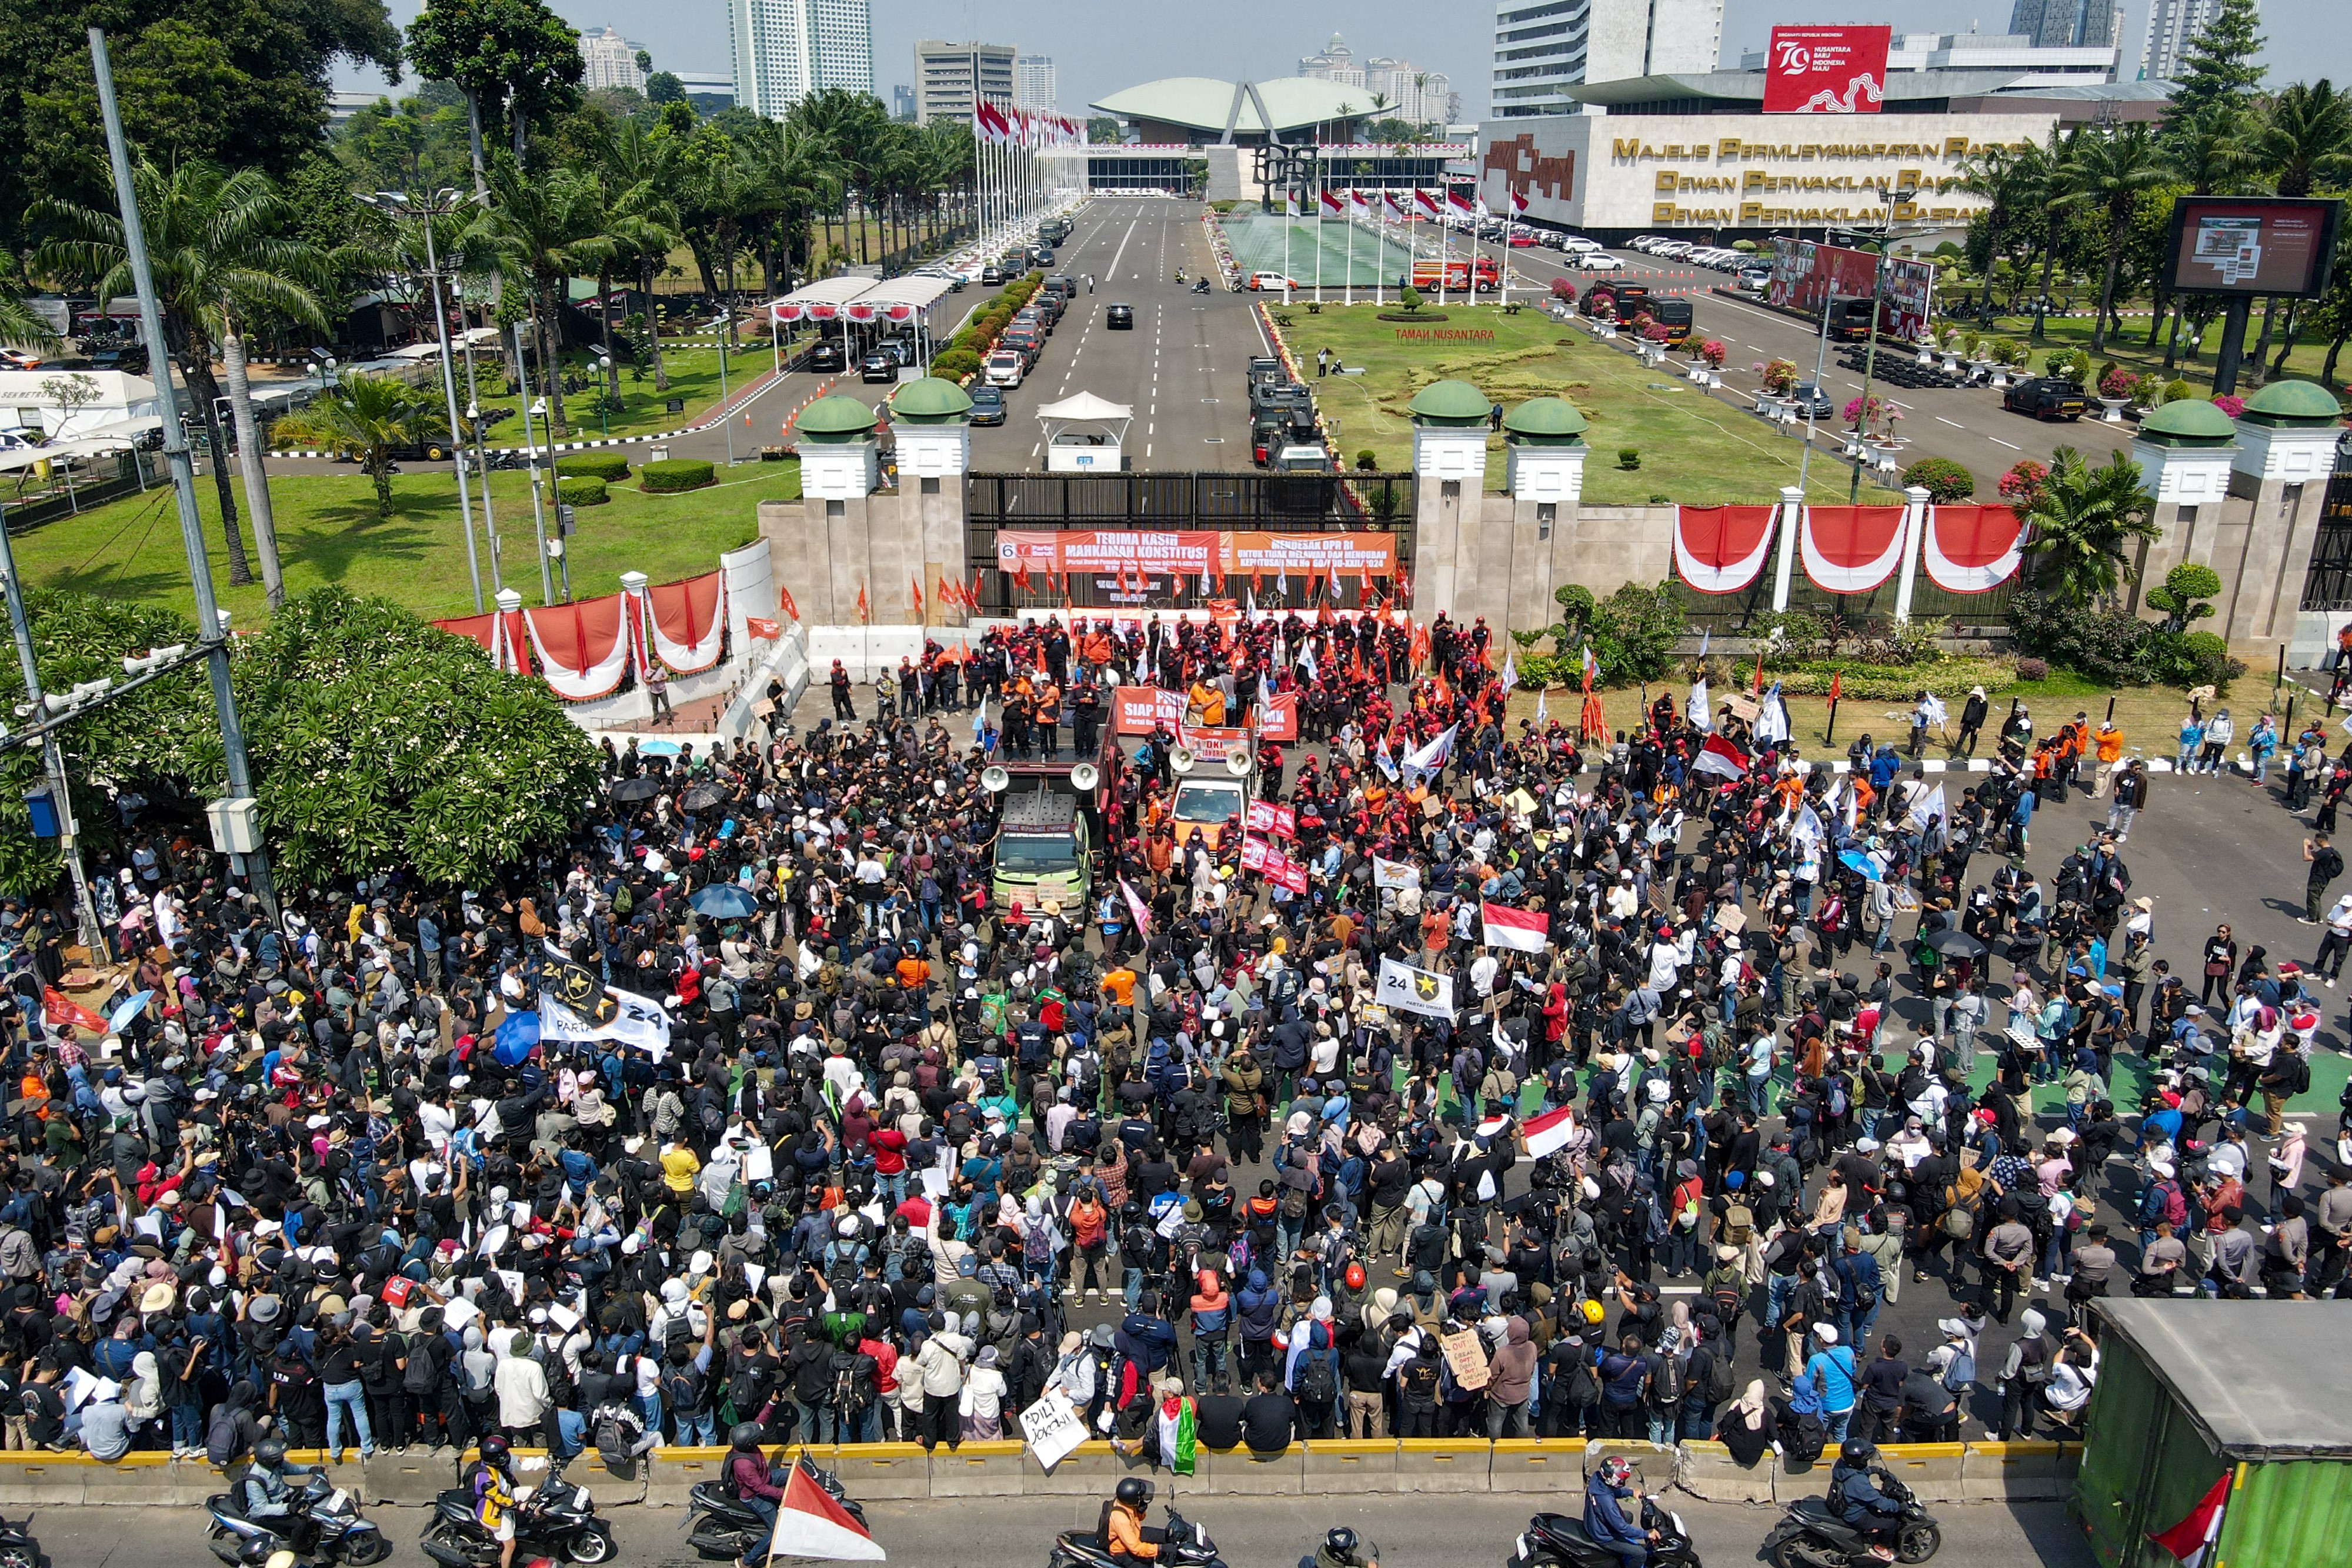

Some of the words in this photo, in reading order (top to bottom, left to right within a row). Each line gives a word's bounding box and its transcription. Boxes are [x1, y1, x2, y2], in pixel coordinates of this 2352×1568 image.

[1612, 138, 1710, 158] MAJELIS
[1717, 138, 1939, 157] PERMUSYAWARATAN
[1656, 171, 1737, 189] DEWAN
[1743, 170, 1891, 189] PERWAKILAN
[1652, 202, 1733, 221] DEWAN
[1739, 202, 1886, 221] PERWAKILAN
[1433, 329, 1494, 339] NUSANTARA
[1095, 532, 1139, 545] TERIMA
[1141, 532, 1178, 546] KASIH
[1271, 540, 1321, 551] MENDESAK
[1323, 540, 1342, 551] DPR
[1343, 540, 1353, 551] RI
[1002, 545, 1013, 557] 6
[1065, 545, 1134, 558] MAHKAMAH
[1136, 546, 1208, 559] KONSTITUSI
[1237, 550, 1263, 559] UNTUK
[1265, 551, 1287, 559] TIDAK
[1288, 551, 1326, 559] MELAWAN
[1345, 551, 1387, 559] MENGUBAH
[1124, 703, 1154, 716] SIAP
[542, 962, 562, 980] 24
[1387, 975, 1407, 990] 24
[1406, 1000, 1425, 1009] PARTAI
[1426, 1003, 1445, 1011] UMMAT
[627, 1005, 662, 1030] 24
[557, 1020, 593, 1033] PARTA
[1032, 1412, 1070, 1445] JOKOWI
